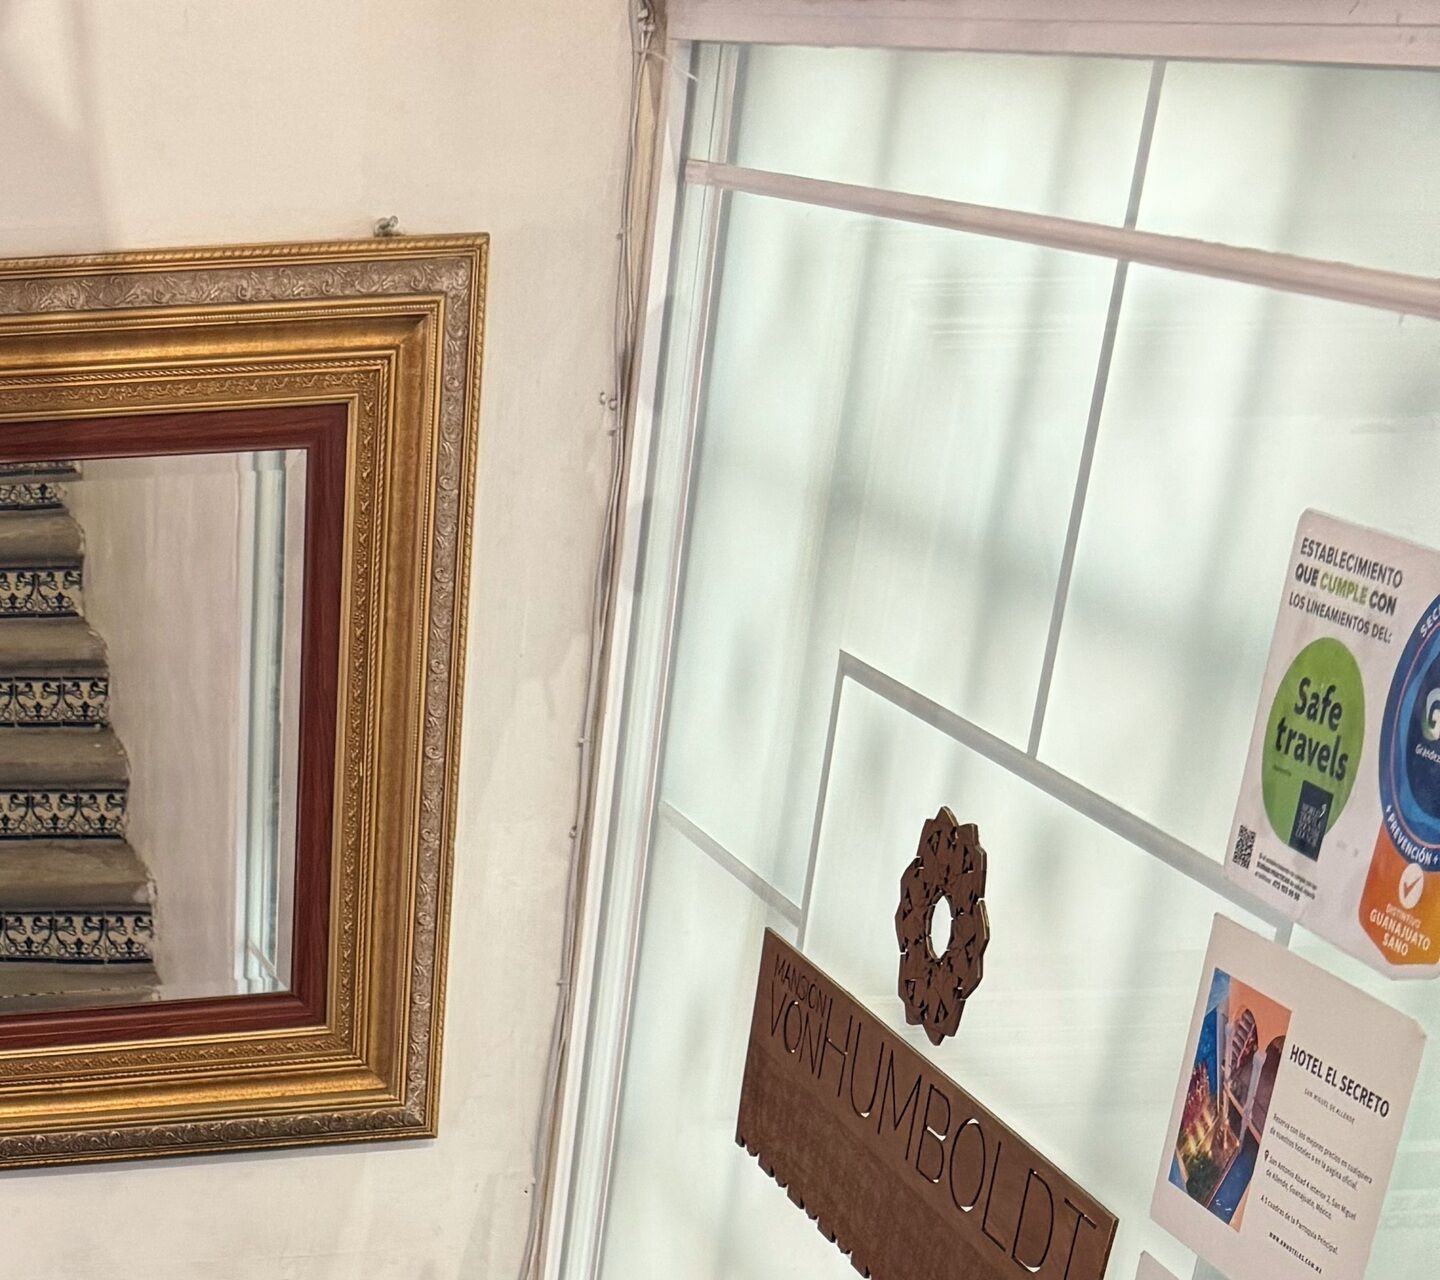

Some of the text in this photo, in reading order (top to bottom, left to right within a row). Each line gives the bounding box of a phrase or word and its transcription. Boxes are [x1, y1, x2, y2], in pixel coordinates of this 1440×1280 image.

[1300, 537, 1403, 589] ESTABLECIMIENTO
[1295, 563, 1398, 616] QUE CUMPLE CON
[1289, 592, 1392, 644] LOS LINEAMIENTOS DEL:
[1421, 604, 1440, 638] SEC
[1294, 677, 1342, 732] Safe
[1275, 716, 1349, 781] travels
[1387, 812, 1432, 864] PREVENCIÓN
[1370, 909, 1430, 951] GUANAJUATO
[1382, 932, 1409, 956] SANO
[774, 954, 827, 1018] MANSIÓN
[771, 980, 823, 1075] VON
[1289, 1043, 1390, 1119] HOTEL EL SECRETO
